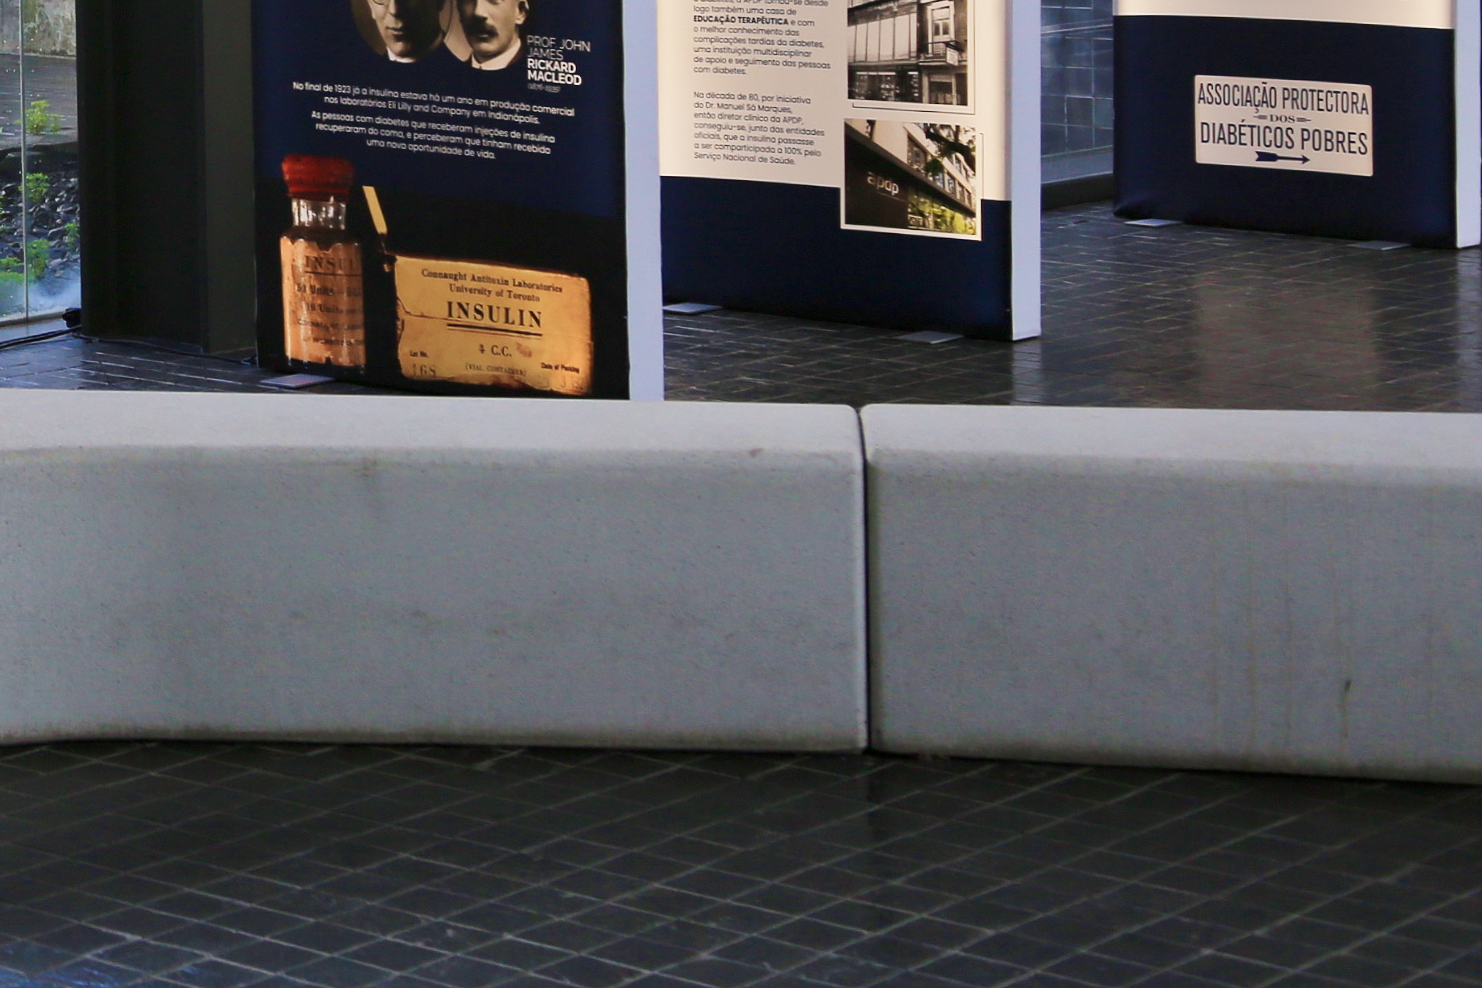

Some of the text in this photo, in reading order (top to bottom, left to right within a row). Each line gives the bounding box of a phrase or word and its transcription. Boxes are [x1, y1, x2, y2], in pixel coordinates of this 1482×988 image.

[693, 14, 736, 24] EDUCAÇÃO
[737, 16, 789, 25] TERAPÊUTICA
[527, 35, 590, 51] PROF. JOHN
[527, 48, 563, 61] JAMES
[526, 58, 578, 74] RICKARD
[527, 70, 582, 85] MACLEOD
[1198, 82, 1369, 115] ASSOCIAÇÃO PROTECTORA
[1270, 114, 1296, 123] DOS
[1200, 119, 1368, 155] DIABÉTICOS POBRES
[867, 174, 899, 195] apdp
[421, 268, 563, 292] Connaught Antitoxin Laboratories
[449, 283, 540, 301] University of Toronto
[447, 302, 541, 327] INSULIN
